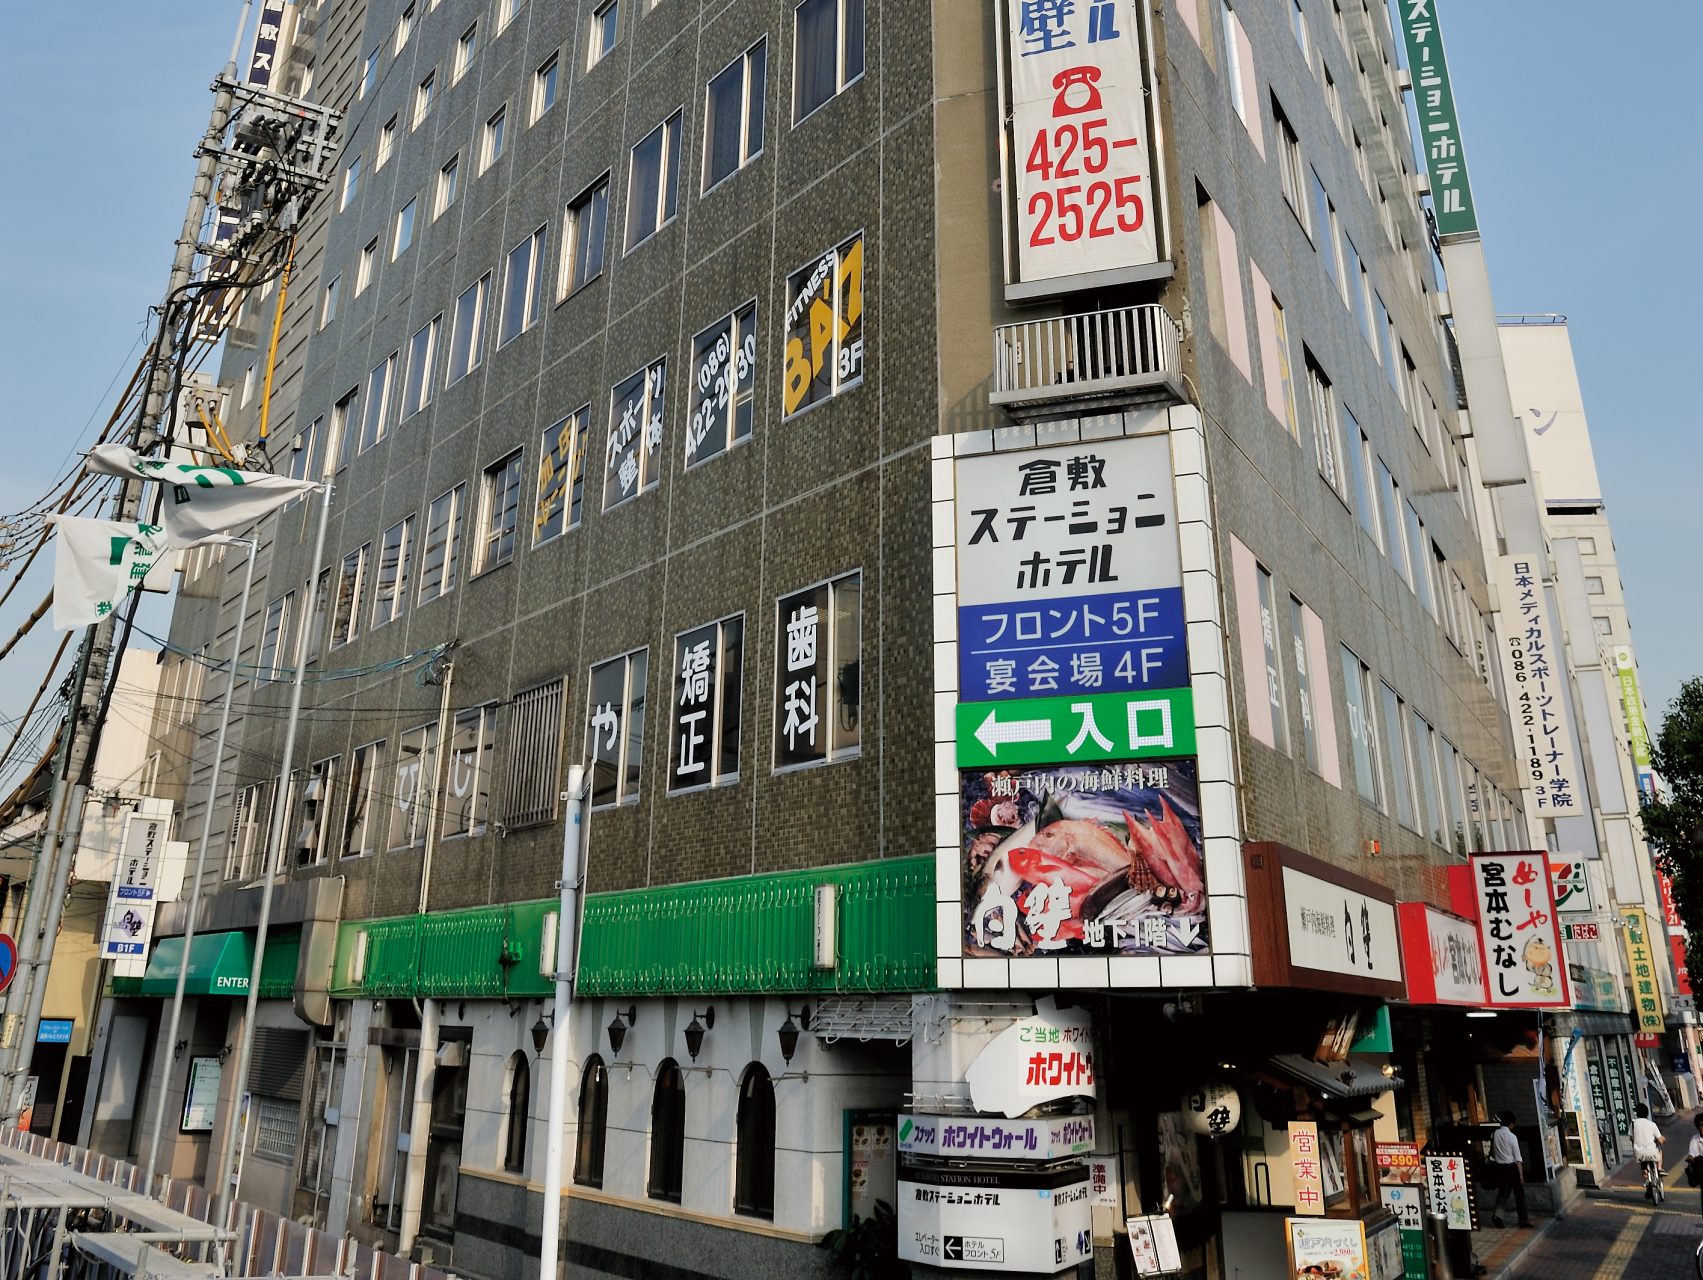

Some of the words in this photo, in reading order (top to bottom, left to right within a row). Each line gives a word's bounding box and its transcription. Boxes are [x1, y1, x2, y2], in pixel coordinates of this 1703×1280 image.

[1029, 175, 1143, 247] 2525
[786, 252, 835, 332] FITNESS
[698, 331, 730, 394] (086)
[838, 339, 862, 379] 3F
[608, 365, 661, 468] スポーツ
[687, 333, 755, 458] 422-2030
[618, 412, 663, 496] 整体
[1018, 455, 1107, 497] 倉敷
[968, 493, 1166, 546] ステーション
[1016, 545, 1118, 589] ホテル
[784, 605, 818, 751] 歯科
[1261, 604, 1279, 708] 矯正
[1294, 635, 1312, 731] 歯科
[678, 640, 710, 776] 矯正
[1514, 562, 1573, 808] 日本メディカルスポーツトレーナー学院
[592, 701, 618, 760] や
[1065, 699, 1173, 755] 入口
[990, 767, 1170, 798] 瀬戸内の海鮮料理
[1512, 861, 1548, 931] めしや
[117, 944, 136, 953] B1F
[1082, 917, 1168, 949] 地下1階
[1481, 862, 1520, 997] 宮本むなし
[1573, 924, 1598, 939] たばこ
[217, 976, 249, 988] ENTER
[1020, 1026, 1059, 1043] ご当地
[914, 1126, 935, 1144] スナック
[942, 1126, 1037, 1150] ホワイトウォール
[940, 1175, 971, 1183] STATION
[974, 1176, 1000, 1185] HOTEL
[1292, 1130, 1320, 1207] 営業中
[916, 1189, 1000, 1206] 倉敷ステーションホテル
[915, 1232, 939, 1244] エレベーター
[920, 1243, 939, 1256] 入口すぐ
[965, 1249, 989, 1258] フロント
